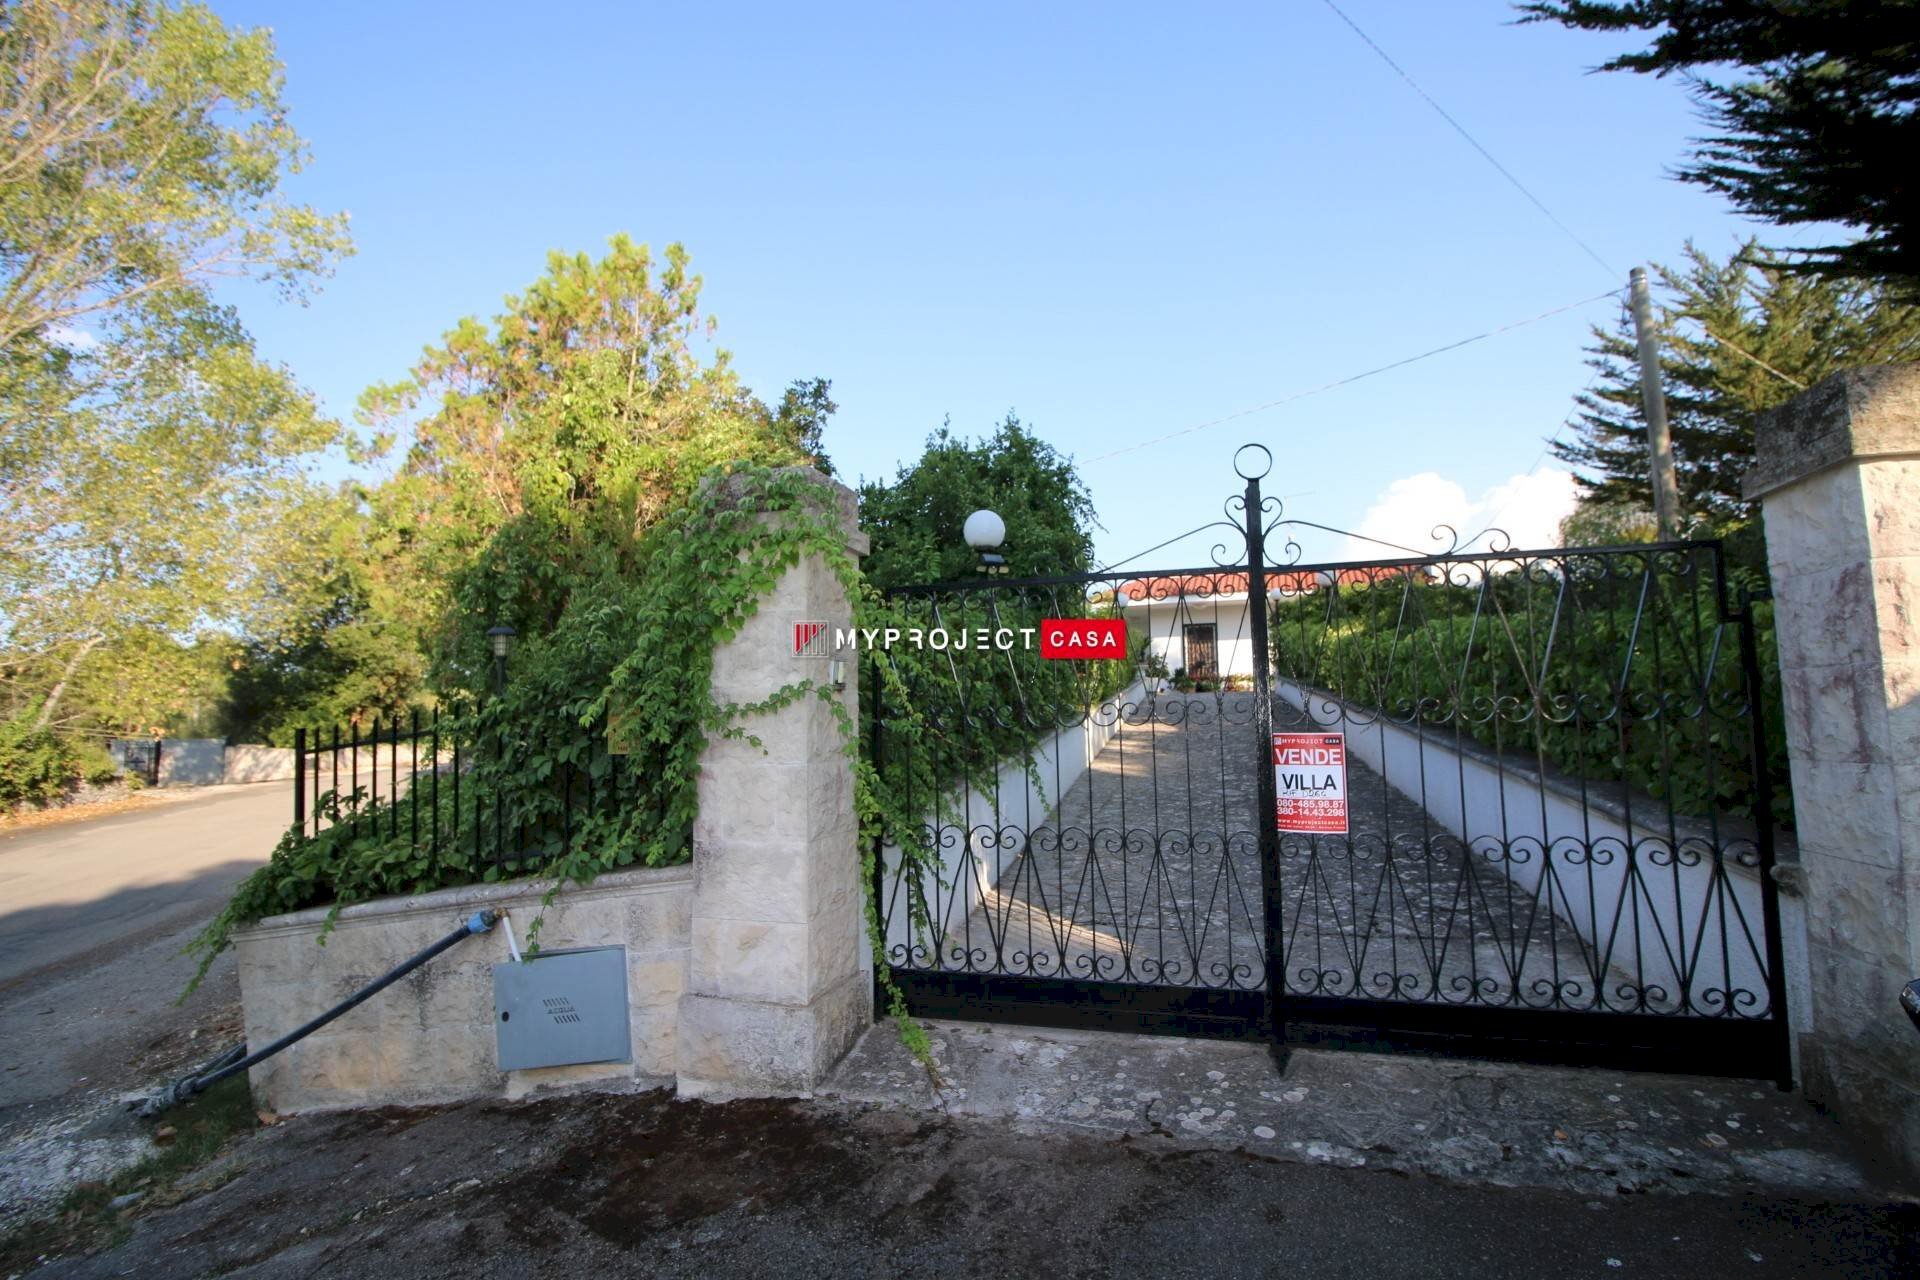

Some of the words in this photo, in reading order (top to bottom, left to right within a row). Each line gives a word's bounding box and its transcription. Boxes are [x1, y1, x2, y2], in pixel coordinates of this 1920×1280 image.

[1275, 748, 1342, 764] VENDE
[1282, 774, 1337, 790] VILLA
[1277, 799, 1344, 809] 080-485.98.87
[1277, 807, 1345, 816] 380-14.43.298
